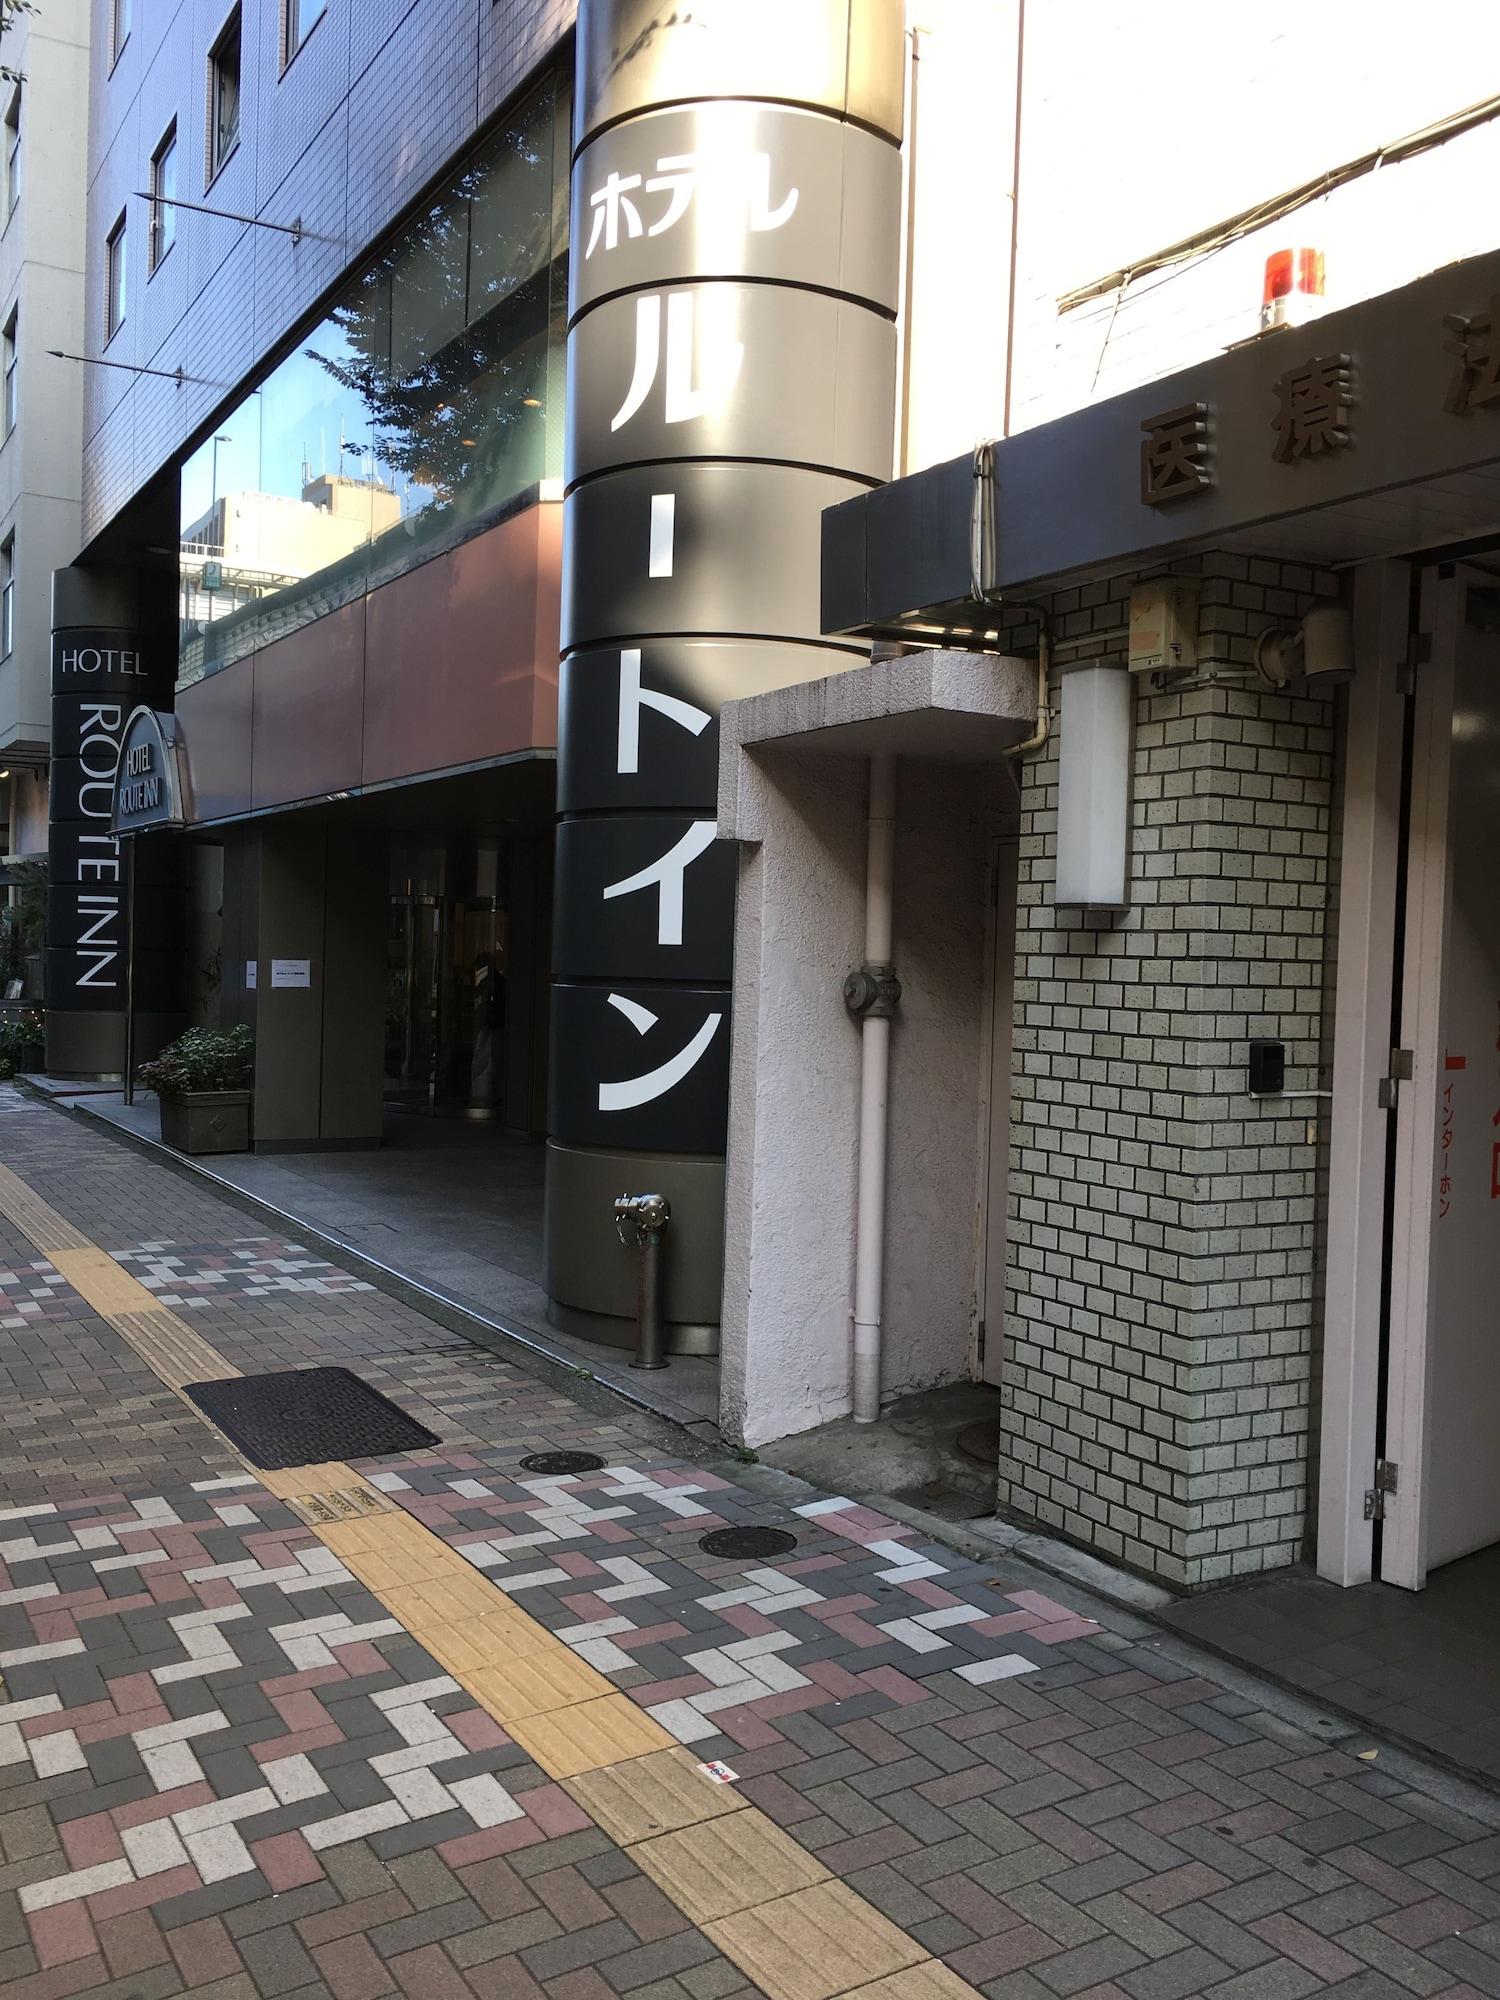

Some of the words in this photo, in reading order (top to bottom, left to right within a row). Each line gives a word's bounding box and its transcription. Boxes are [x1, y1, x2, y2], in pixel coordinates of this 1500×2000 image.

[62, 648, 148, 675] HOTEL
[599, 292, 744, 1111] ルートイン
[126, 743, 151, 777] HOTEL
[1439, 1083, 1454, 1218] インターホン
